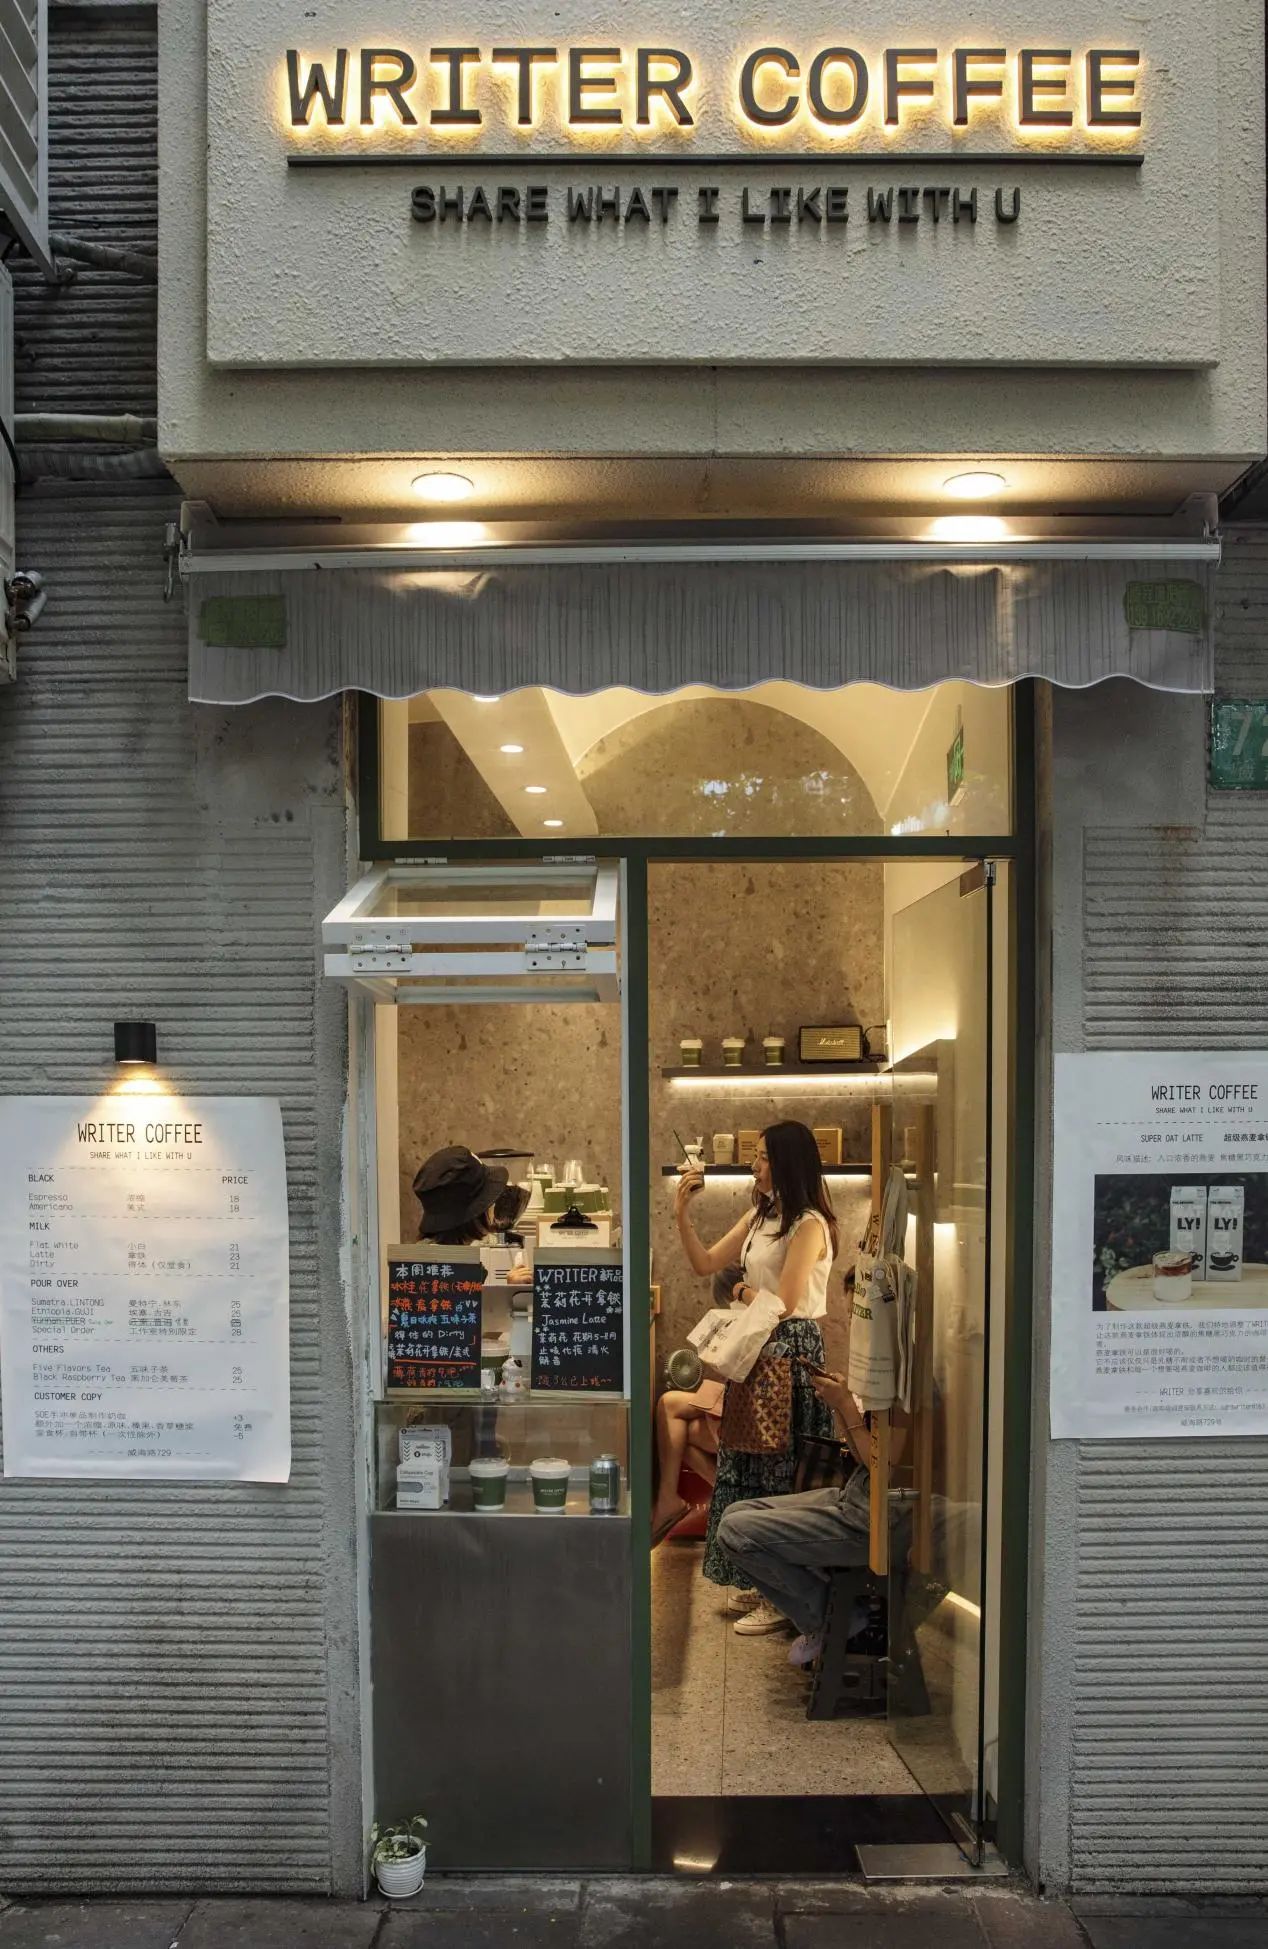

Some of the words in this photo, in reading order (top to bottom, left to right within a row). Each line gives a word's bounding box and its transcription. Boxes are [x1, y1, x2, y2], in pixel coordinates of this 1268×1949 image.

[286, 47, 694, 125] WRITER
[739, 47, 1142, 126] COFFEE
[411, 186, 549, 222] SHARE
[567, 186, 678, 223] WHAT
[698, 186, 720, 223] I
[742, 186, 849, 223] LIKE
[867, 186, 977, 224] WITH
[995, 187, 1021, 224] U
[1151, 1085, 1201, 1100] WRITER
[1209, 1084, 1258, 1099] COFFEE
[1156, 1106, 1176, 1114] SHARE
[1179, 1106, 1196, 1114] WHAT
[1208, 1106, 1224, 1114] LIKE
[78, 1123, 136, 1143] WRITER
[145, 1123, 203, 1143] COFFEE
[1140, 1134, 1162, 1143] SUPER
[1166, 1134, 1178, 1143] OAT
[1182, 1133, 1203, 1142] LATTE
[90, 1151, 111, 1160] SHARE
[114, 1152, 133, 1160] WHAT
[144, 1152, 162, 1160] LIKE
[166, 1152, 183, 1161] WITH
[28, 1174, 55, 1182] BLACK
[222, 1176, 248, 1184] PRICE
[28, 1193, 68, 1202] Espresso
[28, 1202, 73, 1211] Americano
[29, 1222, 50, 1230] MILK
[30, 1241, 49, 1249] Flat
[53, 1241, 79, 1250] White
[30, 1250, 54, 1258] Latte
[30, 1260, 56, 1269] Dirty
[395, 1264, 454, 1279] 本周推荐
[31, 1279, 52, 1288] POUR
[57, 1279, 78, 1288] OVER
[541, 1314, 578, 1327] Jasmine
[33, 1326, 66, 1336] Special
[70, 1326, 95, 1335] Order
[438, 1330, 465, 1341] Dirty
[32, 1345, 64, 1353] OTHERS
[33, 1364, 53, 1372] Five
[57, 1364, 91, 1373] Flavors
[96, 1365, 111, 1373] Tea
[33, 1373, 57, 1382] Black
[62, 1374, 106, 1383] Raspberry
[112, 1375, 126, 1383] Tea
[1159, 1387, 1184, 1396] WRITER
[34, 1392, 77, 1401] CUSTOMER
[81, 1393, 103, 1402] COPY
